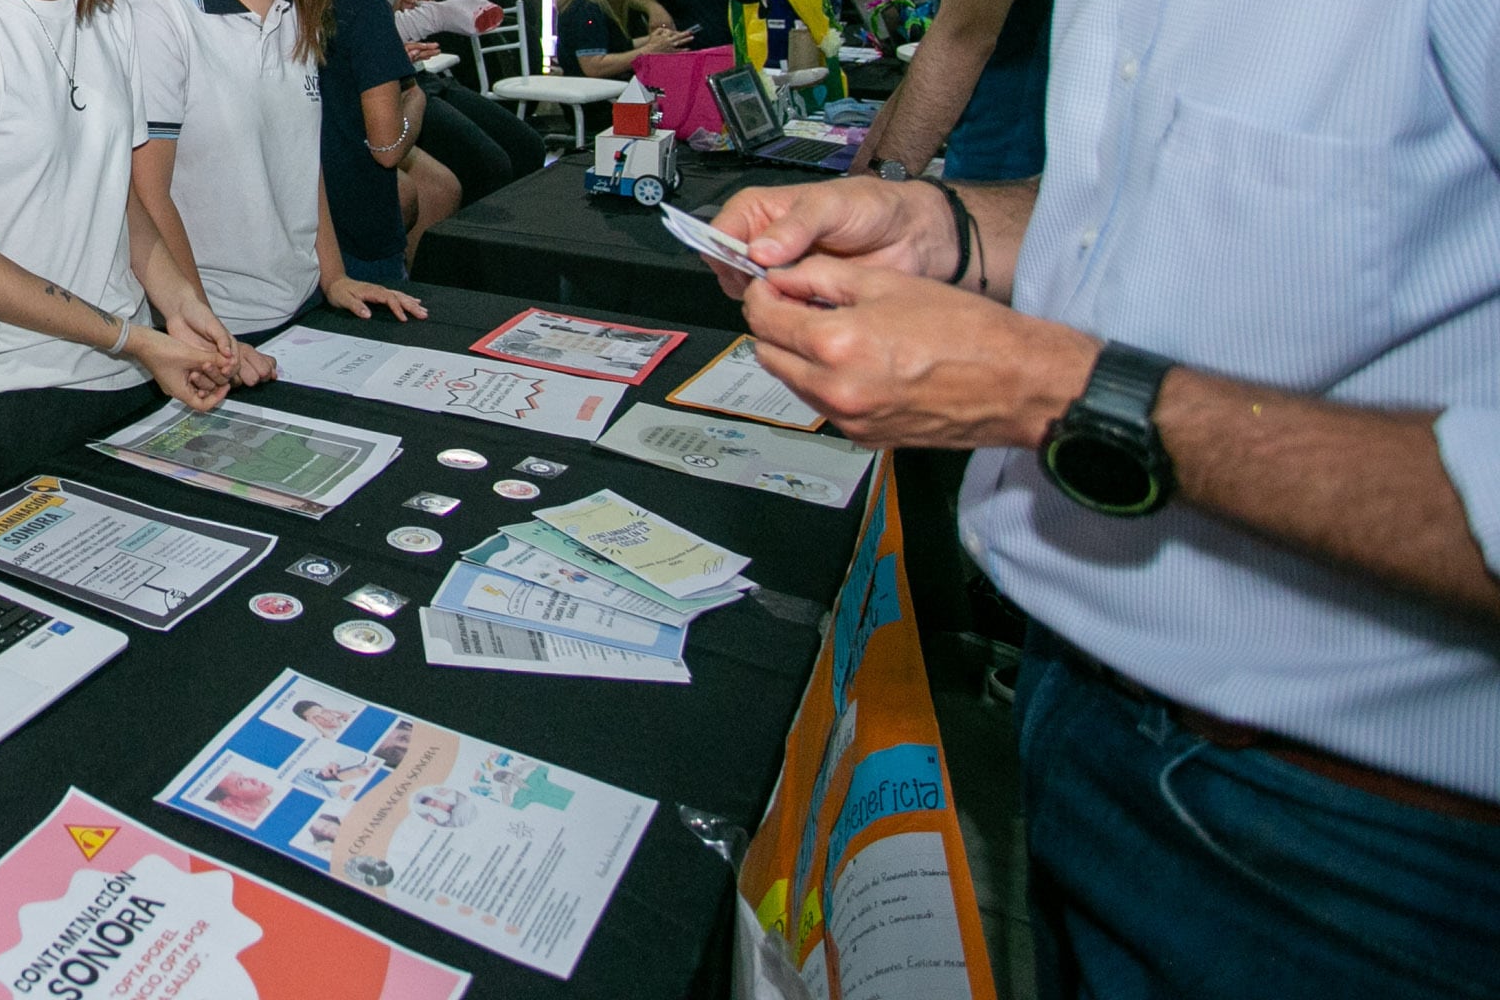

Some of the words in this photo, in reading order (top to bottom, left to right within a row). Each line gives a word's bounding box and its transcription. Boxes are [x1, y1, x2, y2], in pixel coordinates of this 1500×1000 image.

[2, 511, 64, 546] SONORA
[13, 869, 137, 994] CONTAMINACIÓN
[47, 894, 166, 1000] SONORA
